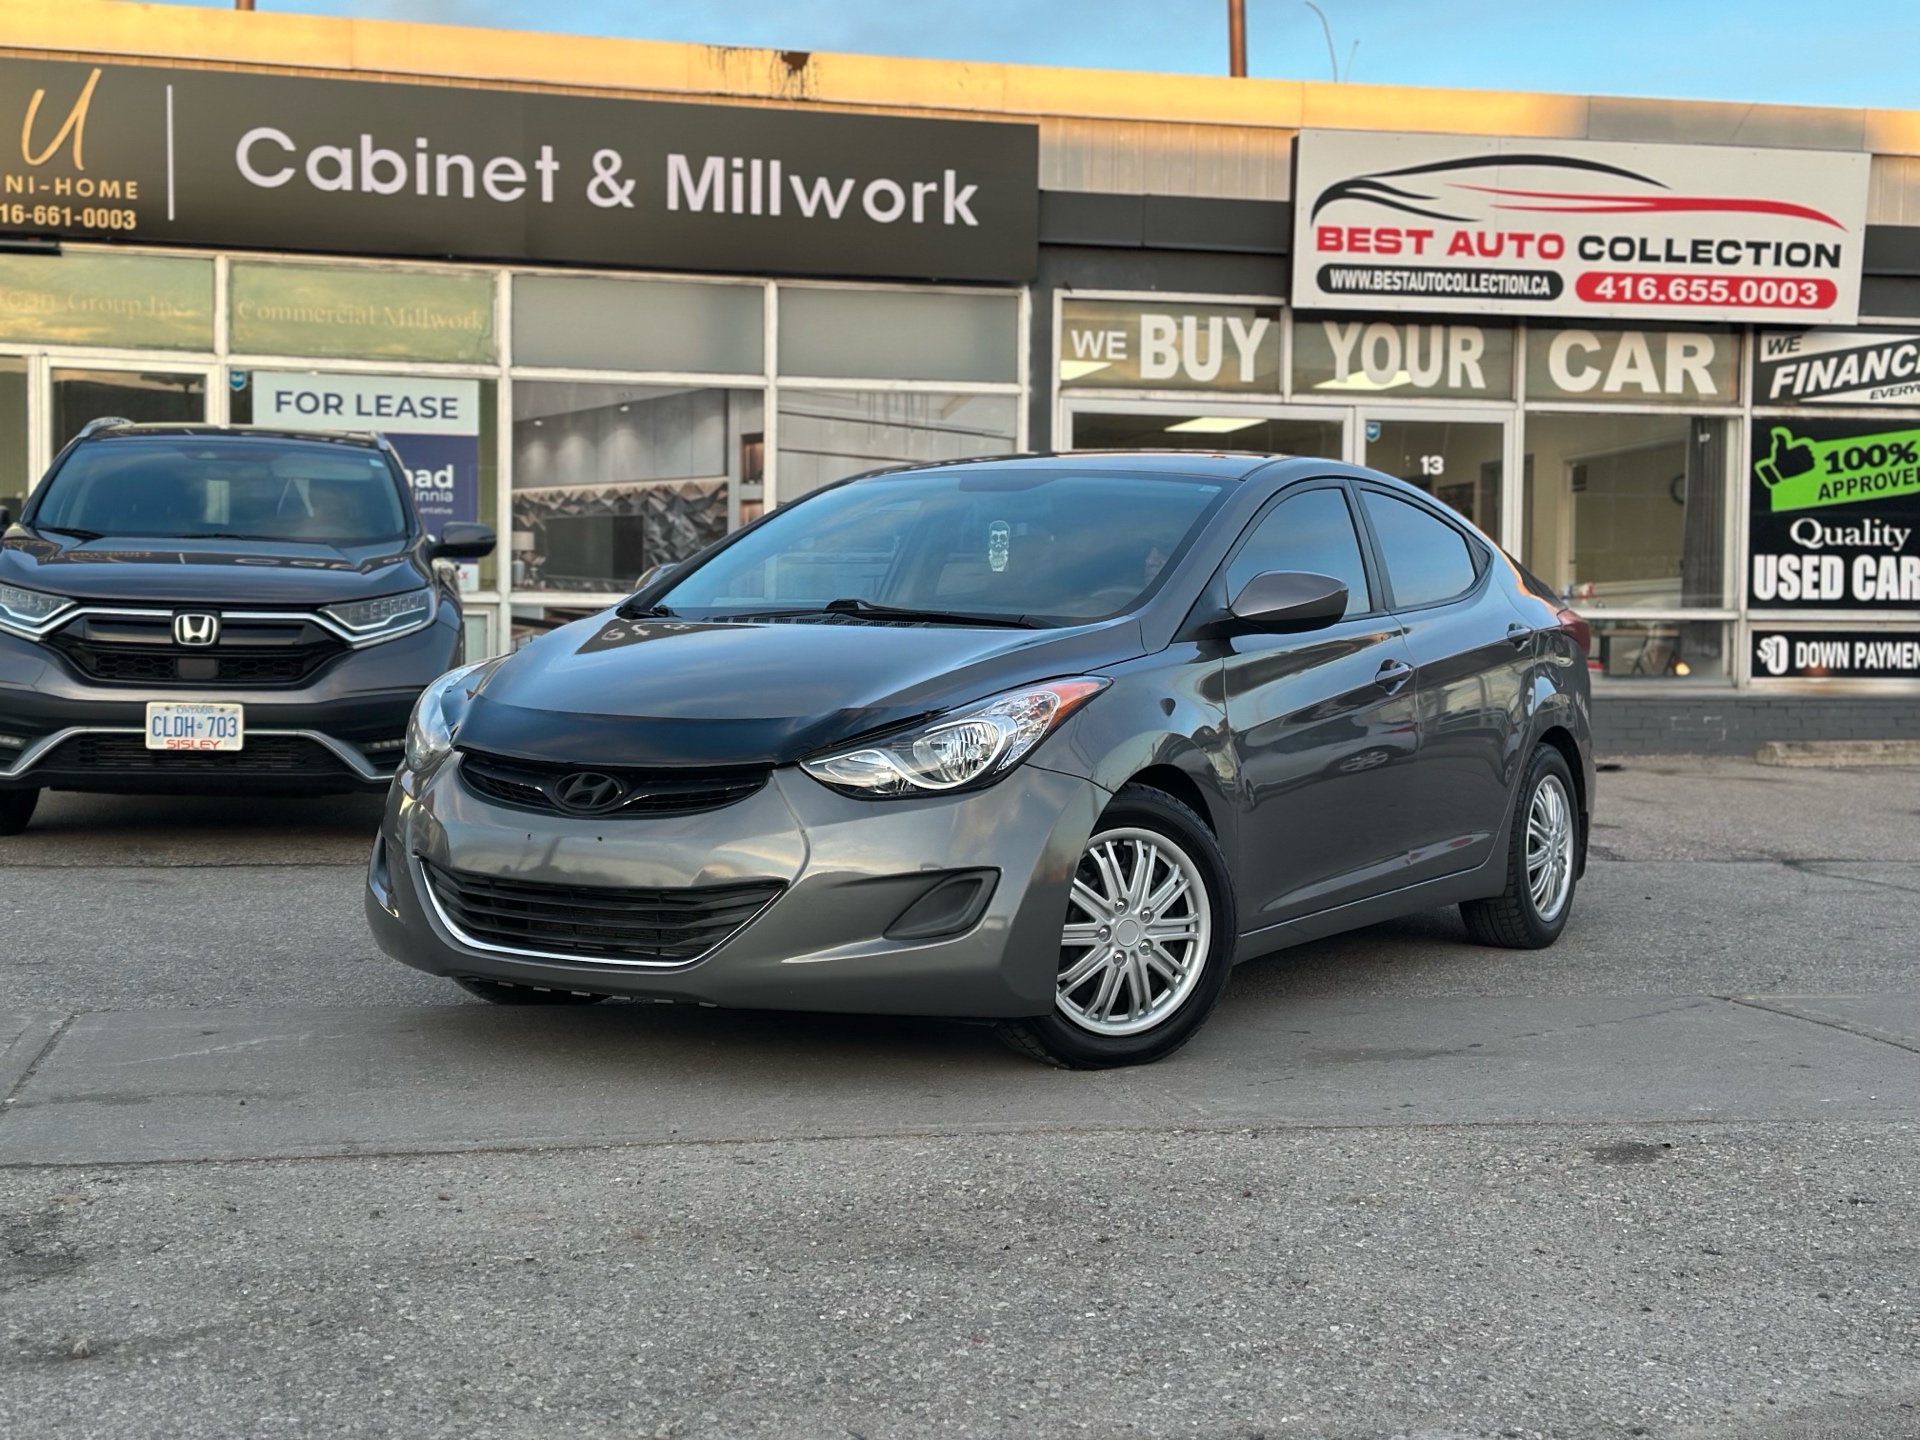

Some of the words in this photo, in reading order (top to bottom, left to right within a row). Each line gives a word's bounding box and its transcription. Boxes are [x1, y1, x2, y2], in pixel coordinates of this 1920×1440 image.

[235, 127, 560, 203] Cabinet
[585, 148, 635, 209] &
[667, 154, 979, 226] Millwork
[0, 203, 136, 230] 16-661-0003
[1316, 225, 1434, 257] BEST
[1447, 230, 1565, 261] AUTO
[1578, 235, 1842, 269] COLLECTION
[1330, 268, 1551, 297] WWW.BESTAUTOCOLLECTION.CA
[1595, 275, 1819, 307] 416.655.0003
[67, 291, 142, 320] Group
[237, 300, 376, 325] Commercial
[383, 306, 483, 330] Millwork
[1071, 329, 1127, 361] WE
[1140, 314, 1270, 382] BUY
[1322, 320, 1486, 390] YOUR
[1548, 328, 1718, 395] CAR
[1767, 335, 1802, 356] WE
[1769, 344, 1920, 399] FINANC
[275, 390, 344, 416] FOR
[356, 394, 459, 419] LEASE
[1420, 455, 1444, 475] 13
[1824, 440, 1919, 475] 100%
[1790, 517, 1912, 552] Quality
[1753, 553, 1844, 601] USED
[1795, 641, 1849, 669] DOWN
[152, 715, 195, 738] CLDH
[207, 716, 238, 738] 703
[166, 739, 221, 750] SISLEY
